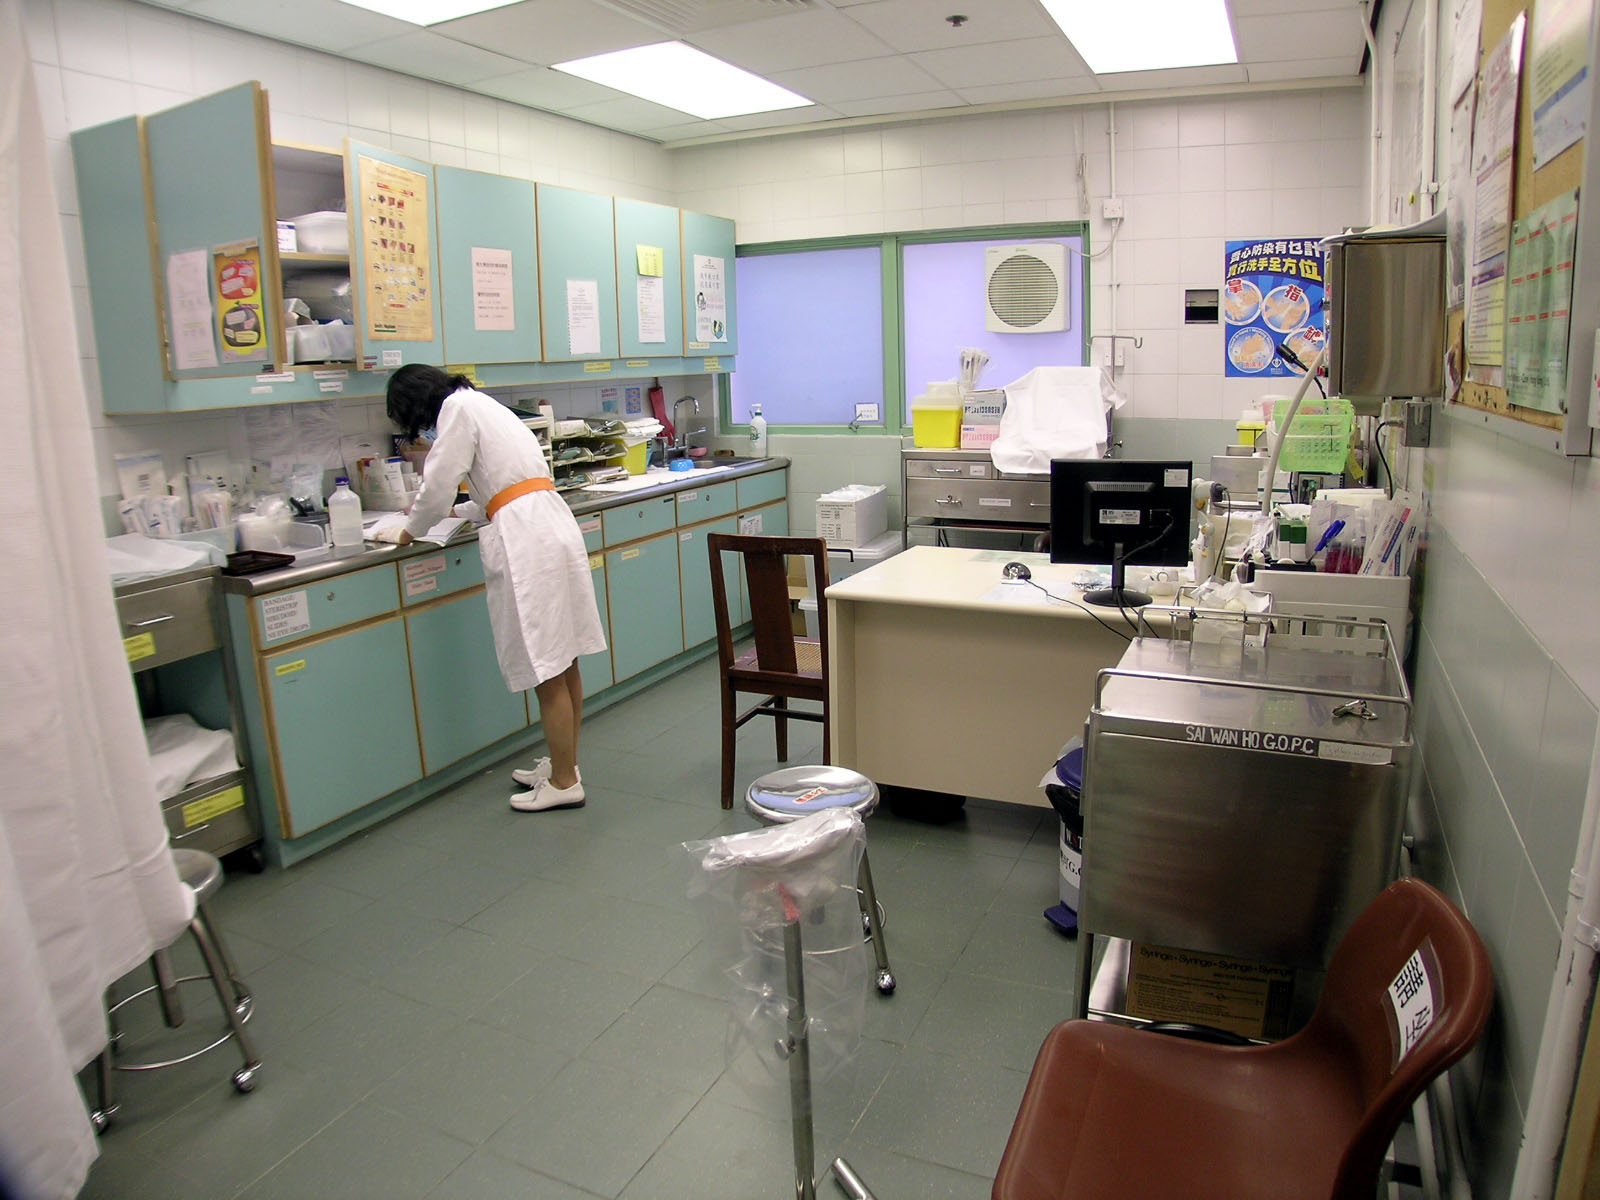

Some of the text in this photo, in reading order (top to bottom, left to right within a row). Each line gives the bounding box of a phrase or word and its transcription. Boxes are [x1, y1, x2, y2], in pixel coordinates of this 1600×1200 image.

[1185, 726, 1205, 742] SAI
[1210, 727, 1239, 745] WAN
[1242, 731, 1260, 749] HO
[1394, 956, 1431, 1052] 請坐
